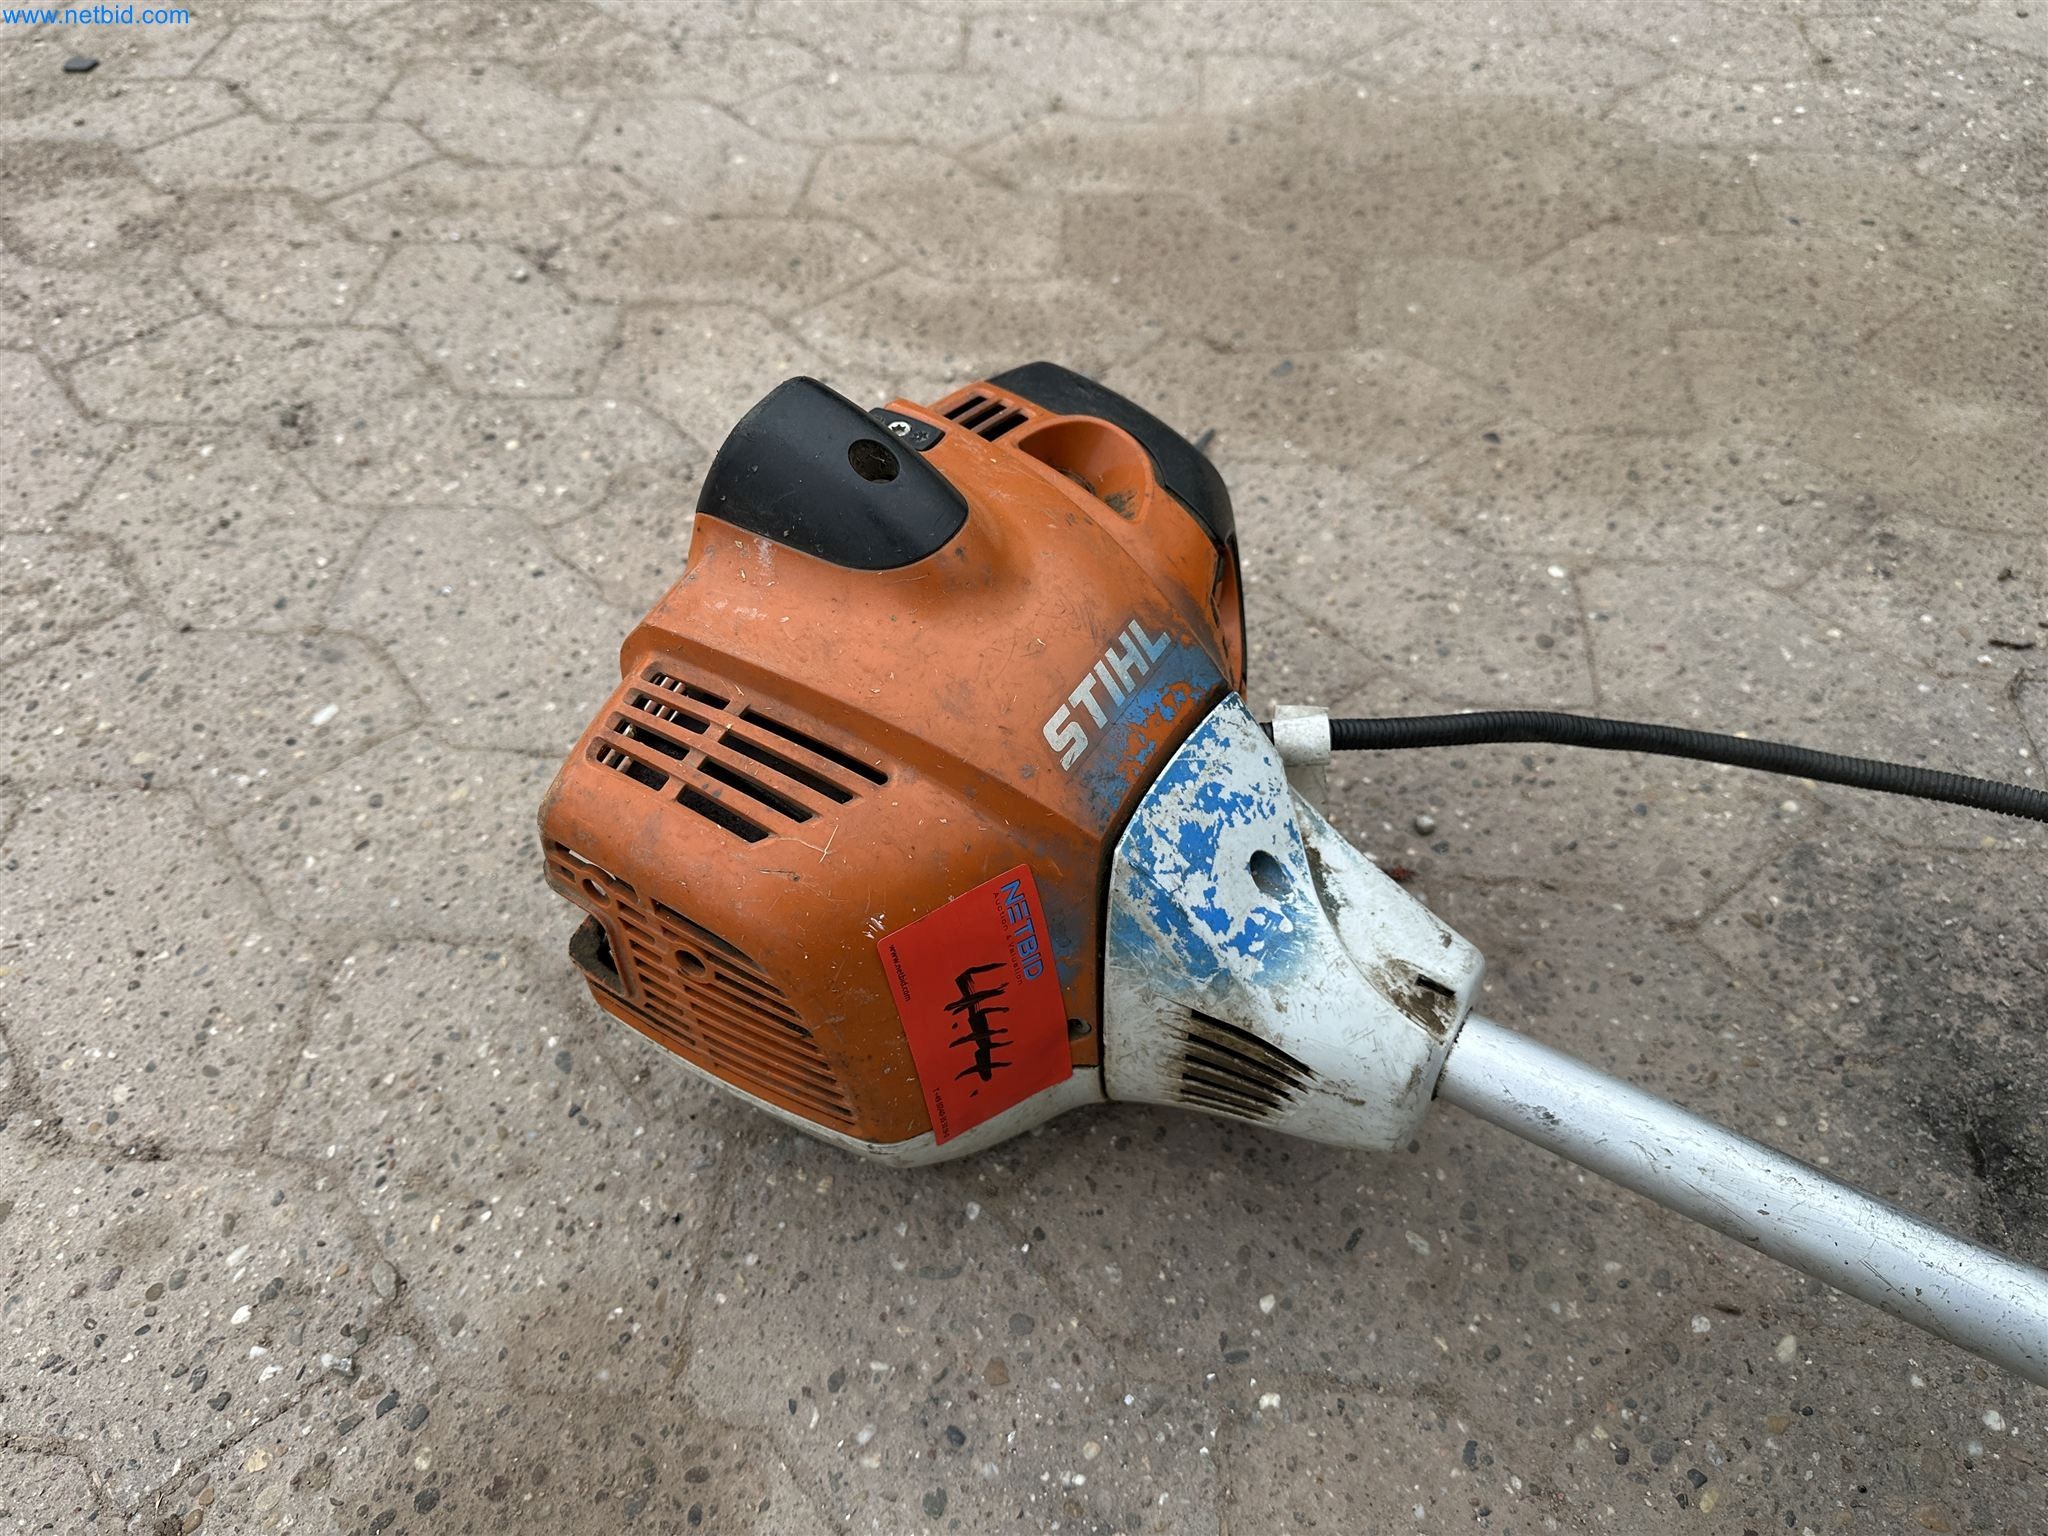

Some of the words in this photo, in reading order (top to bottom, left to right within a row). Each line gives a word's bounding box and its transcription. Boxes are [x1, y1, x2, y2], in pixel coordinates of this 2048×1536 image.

[1043, 619, 1172, 772] STIHL
[889, 944, 911, 1001] www.netbid.com
[993, 892, 1009, 930] Auction
[1008, 942, 1024, 985] Valuation
[1001, 879, 1044, 981] NETBID
